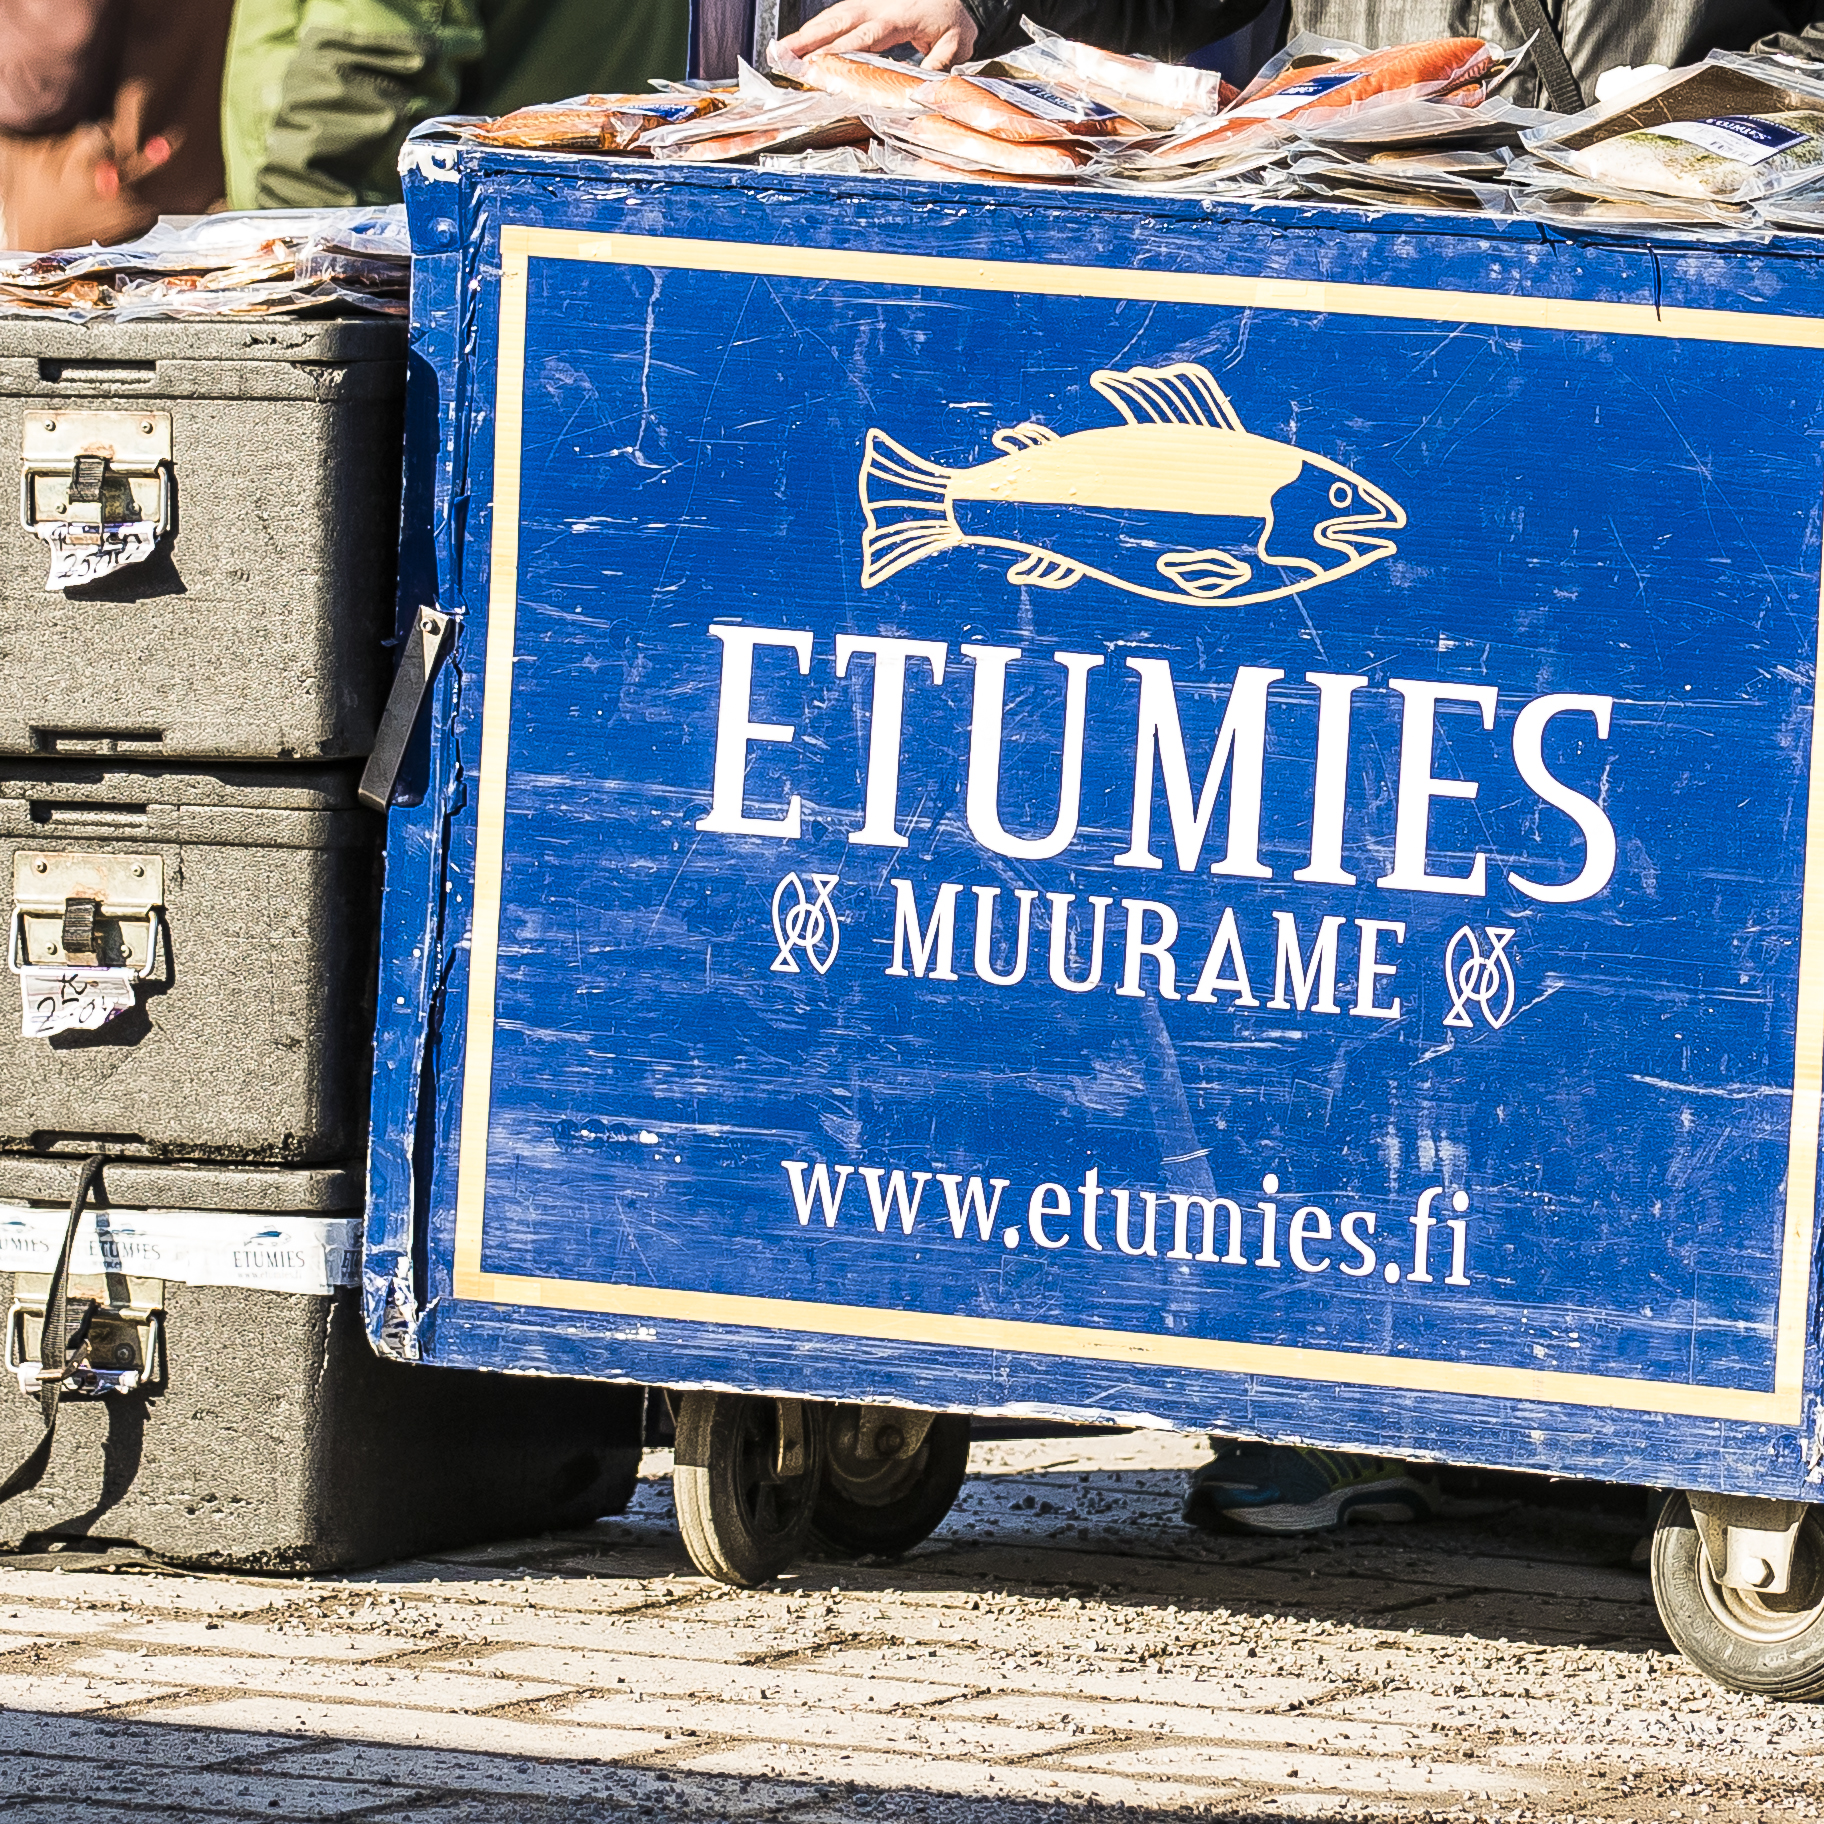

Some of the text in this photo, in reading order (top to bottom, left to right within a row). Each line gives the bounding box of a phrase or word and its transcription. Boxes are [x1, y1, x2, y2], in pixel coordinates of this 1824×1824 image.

[694, 618, 1621, 905] ETUMIES
[884, 879, 1407, 1021] MUURAME
[233, 1249, 306, 1269] ETUMIES
[779, 1157, 1473, 1289] www.etumies.fi
